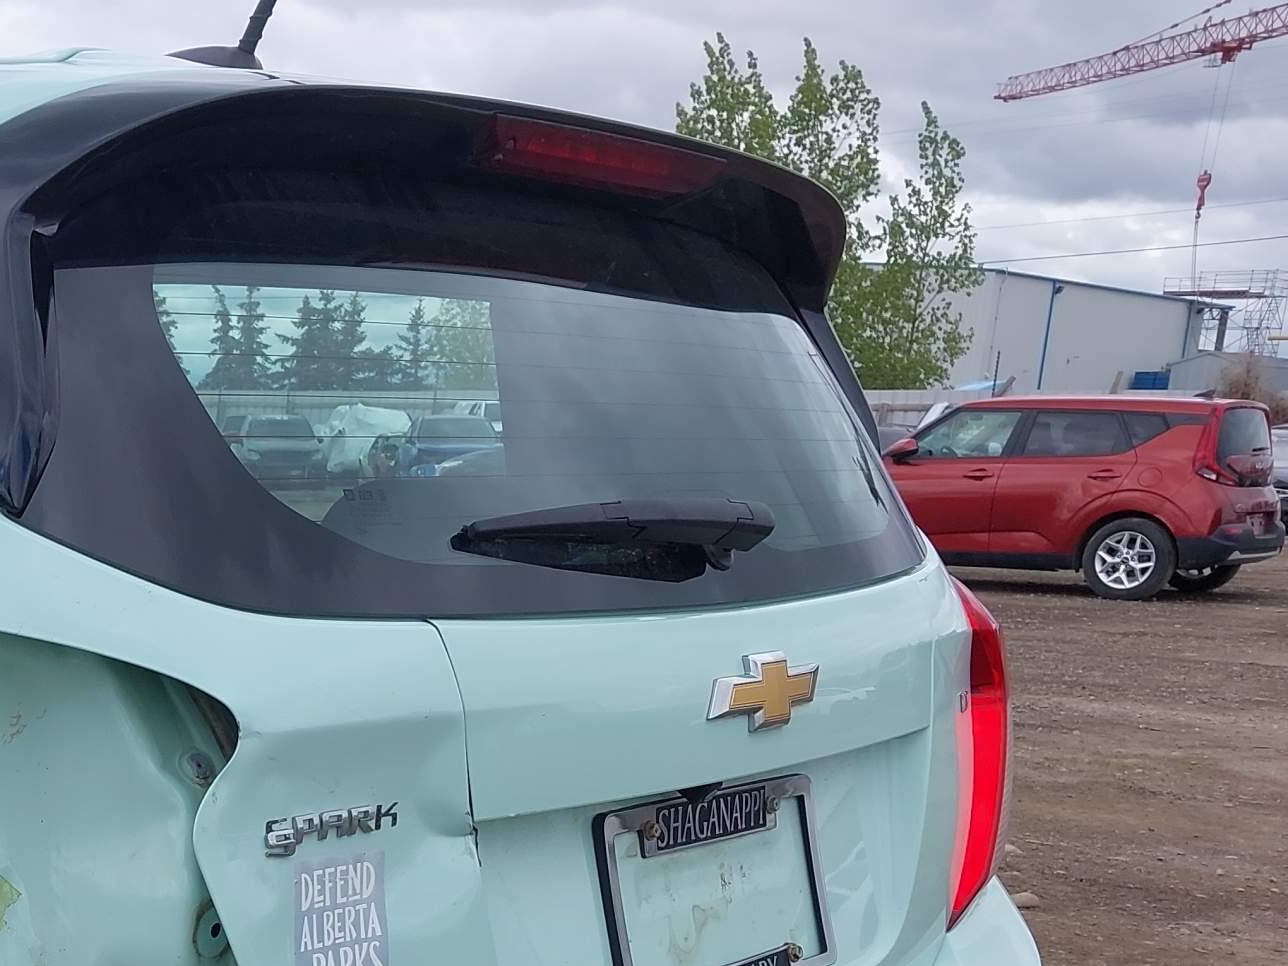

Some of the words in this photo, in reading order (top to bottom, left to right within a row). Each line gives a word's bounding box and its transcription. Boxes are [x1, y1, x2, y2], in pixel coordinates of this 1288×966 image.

[264, 801, 399, 859] SPARK
[658, 788, 766, 848] SHAGANAPPI
[300, 861, 376, 912] DEFEND
[299, 901, 383, 953] ALBERTA
